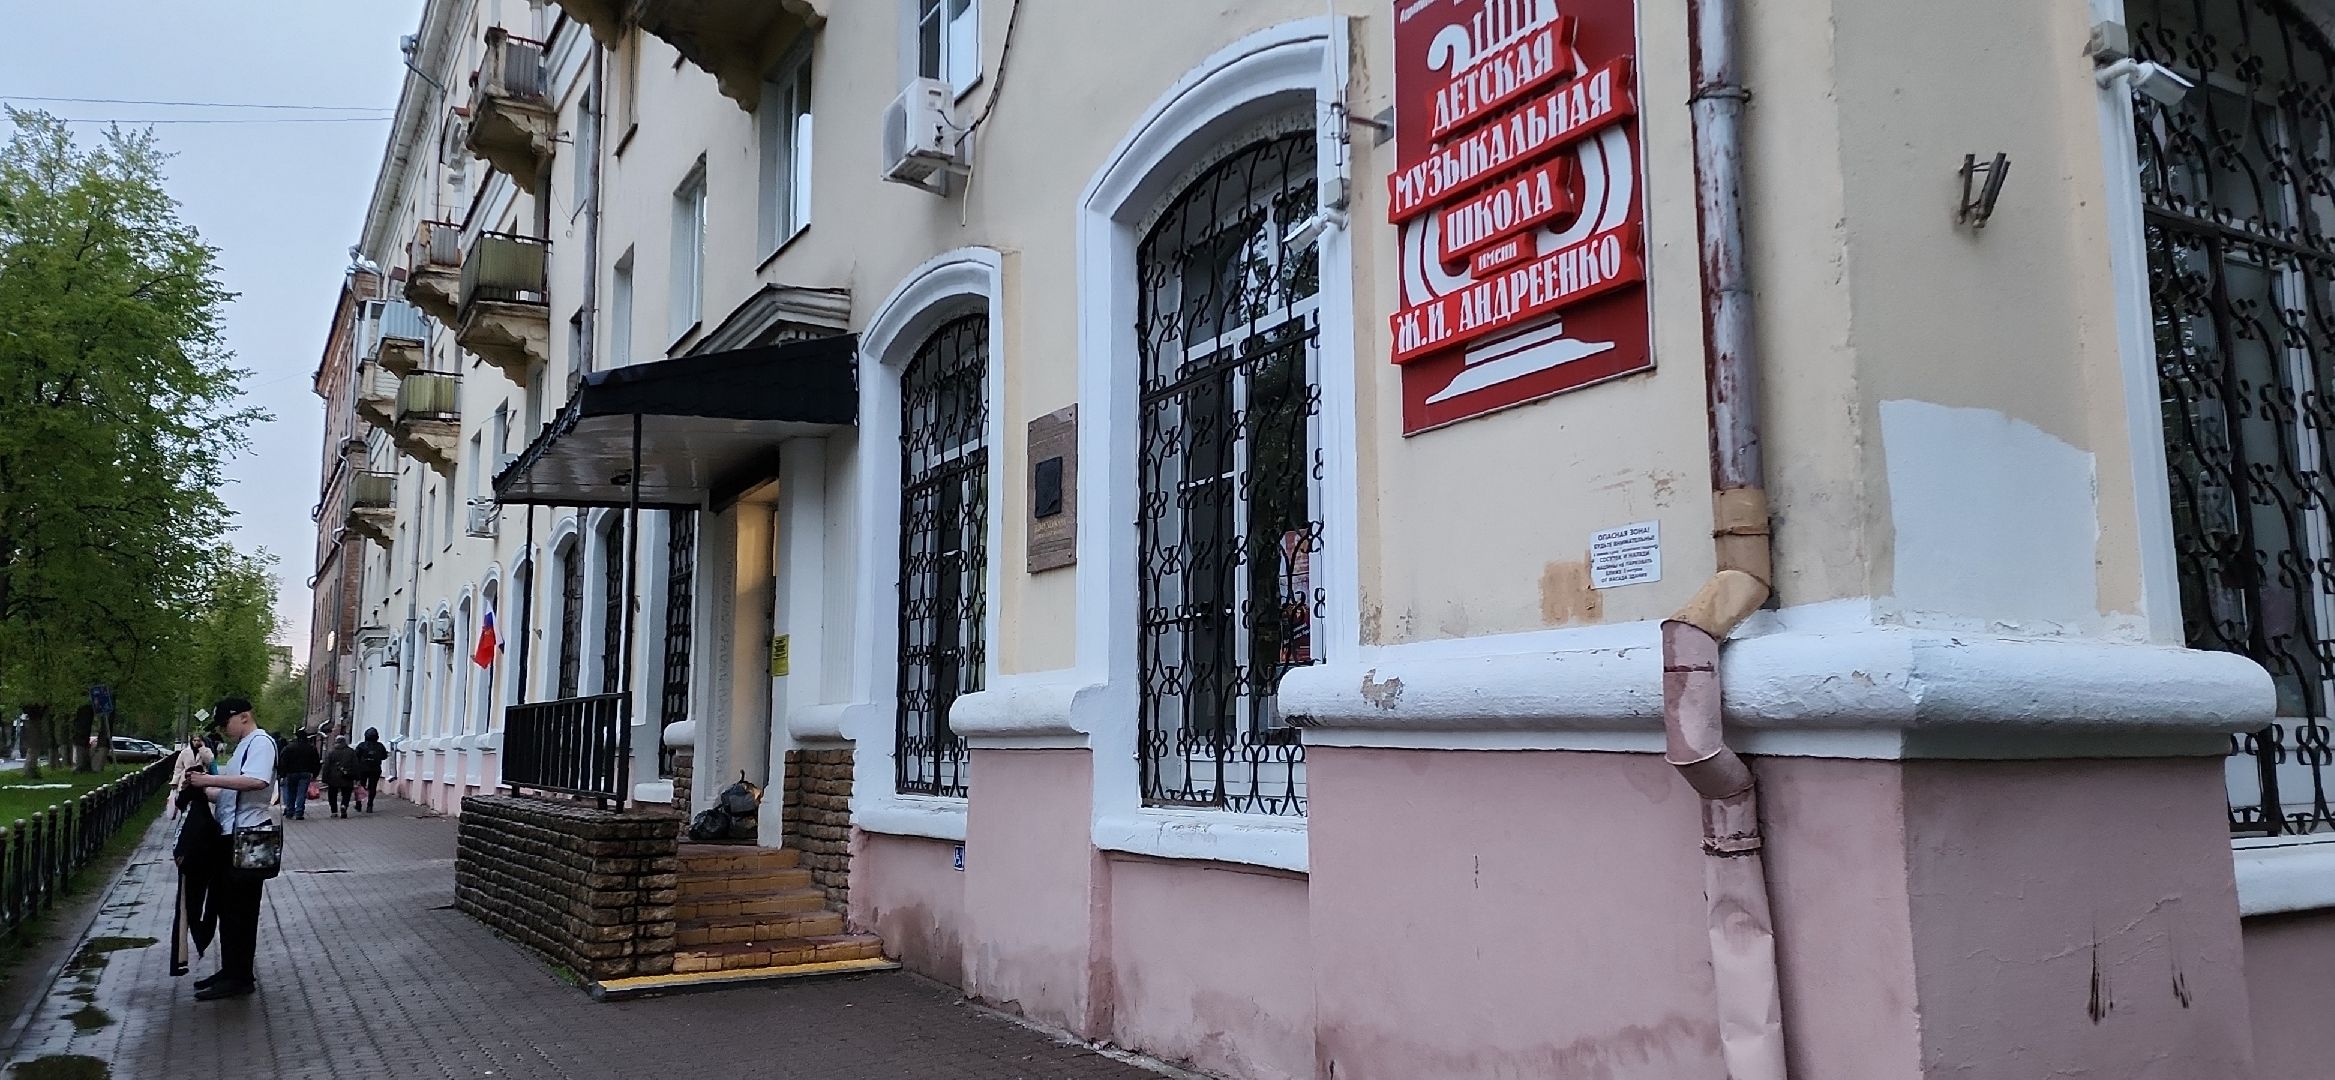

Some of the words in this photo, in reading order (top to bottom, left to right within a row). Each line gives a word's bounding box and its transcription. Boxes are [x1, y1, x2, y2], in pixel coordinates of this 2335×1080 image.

[1432, 27, 1554, 138] ДЕТСКАЯ
[1395, 67, 1612, 214] МУЗЫКАЛЬНАЯ
[1446, 169, 1554, 253] ШКОЛА
[1477, 240, 1518, 272] имени
[1396, 301, 1453, 355] Ж.И.
[1458, 234, 1622, 333] АНДРЕЕНКО
[1598, 531, 1628, 541] ОПАСНАЯ
[1629, 526, 1650, 536] ЗОНА!
